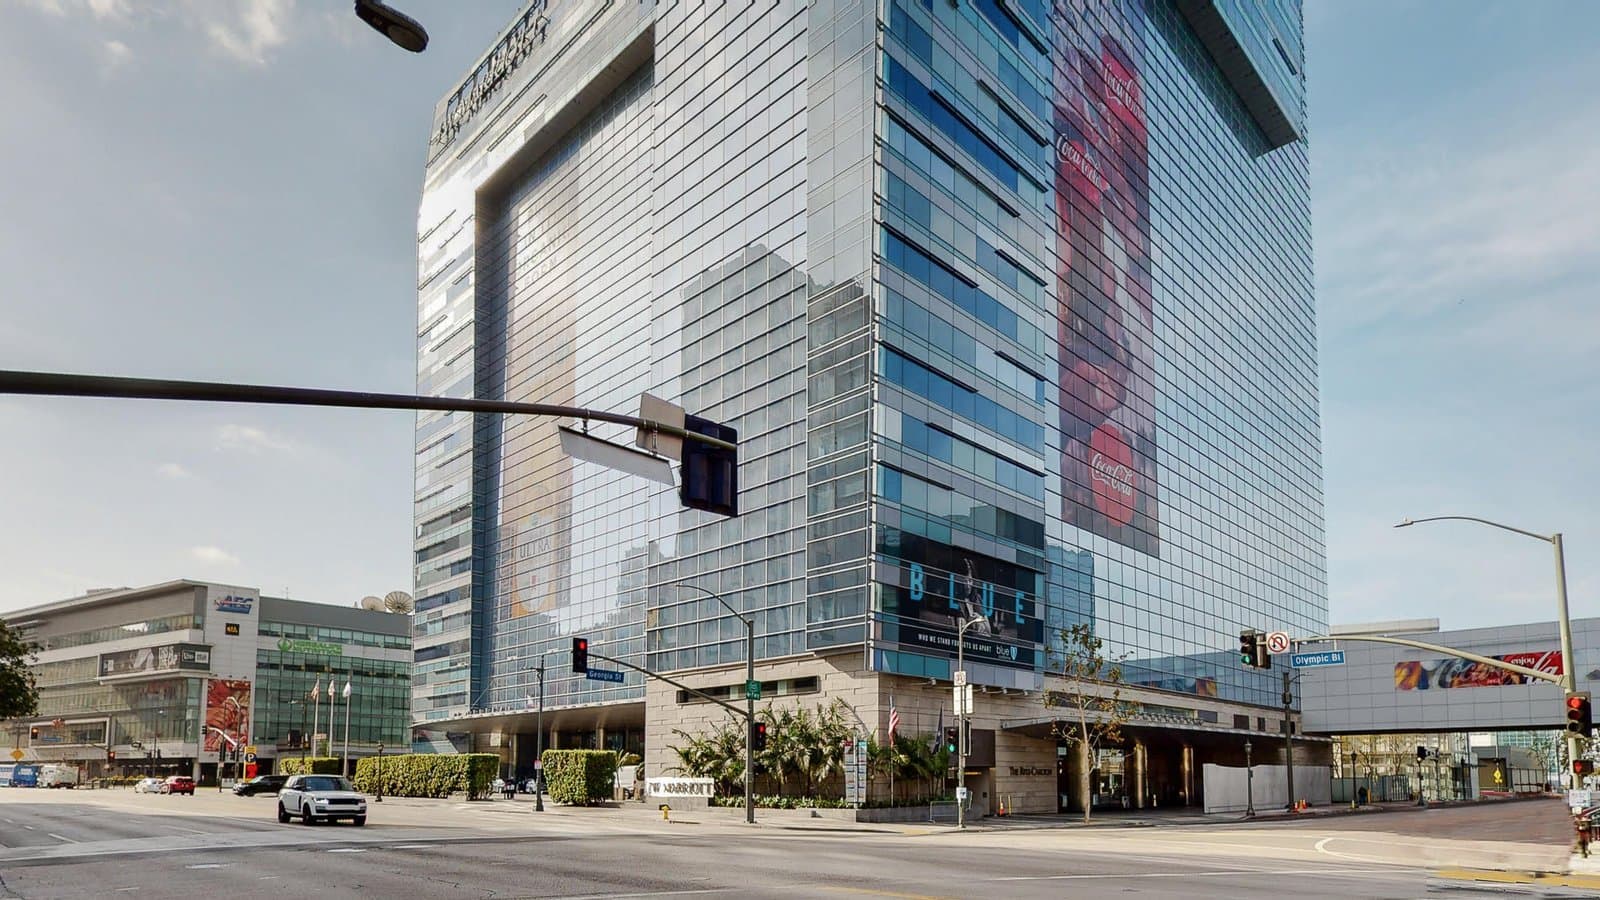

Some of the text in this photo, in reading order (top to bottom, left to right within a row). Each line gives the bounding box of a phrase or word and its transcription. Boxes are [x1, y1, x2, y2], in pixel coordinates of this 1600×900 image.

[1091, 453, 1133, 496] Coca-Cola
[910, 563, 1025, 624] BLUE
[1295, 653, 1341, 665] Olympic Bl
[1511, 657, 1535, 666] enjoy
[589, 671, 613, 680] Georgia
